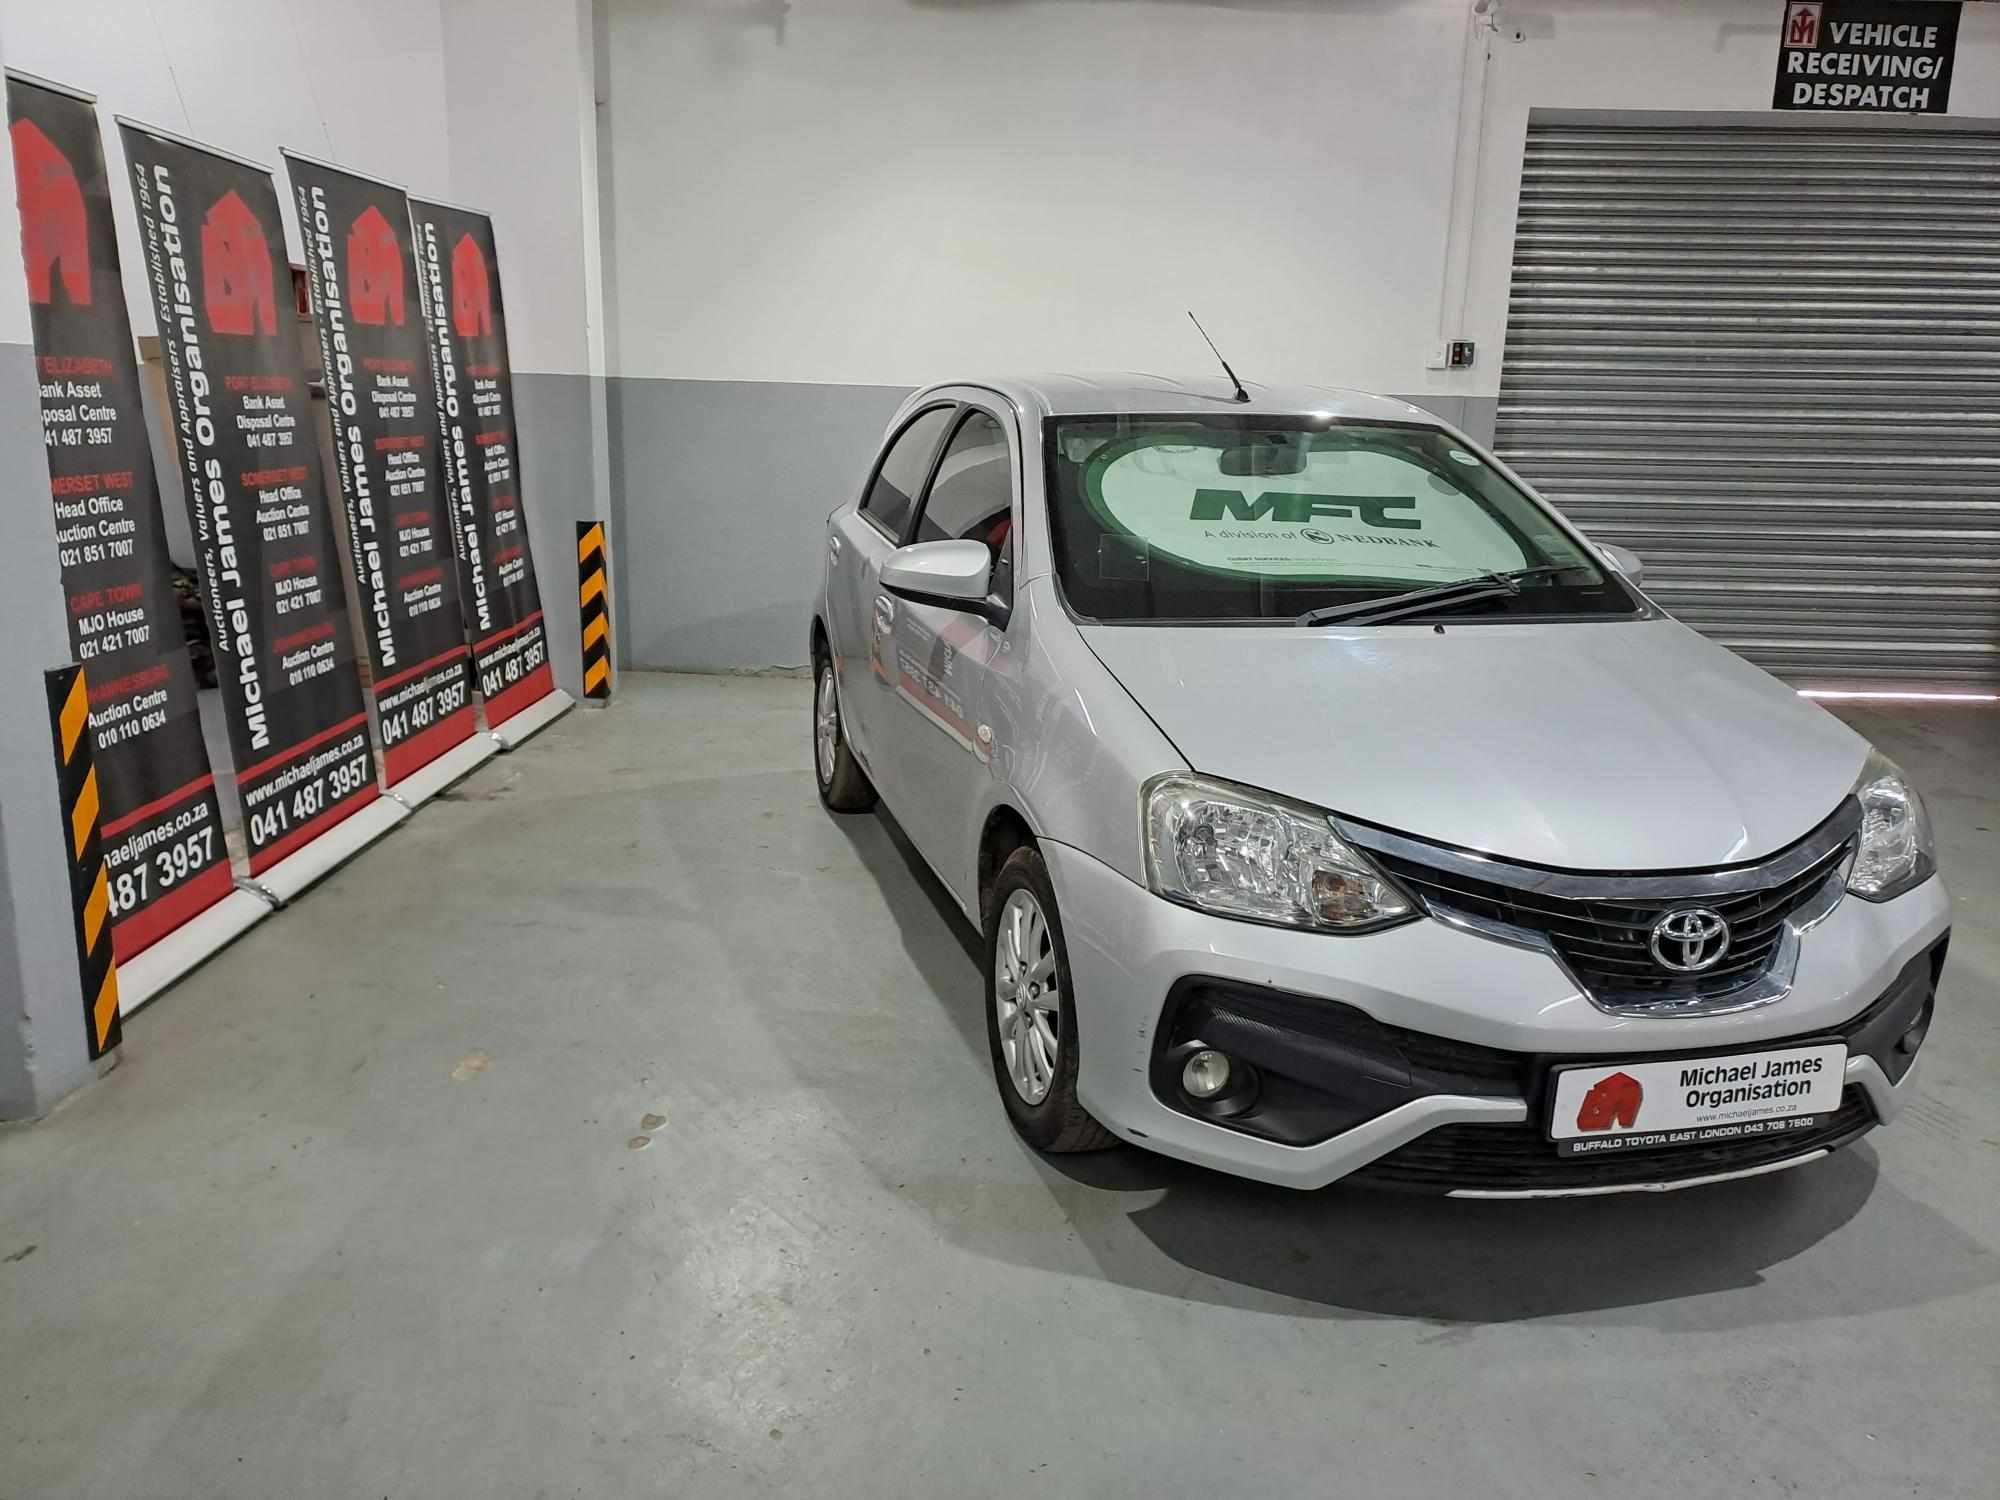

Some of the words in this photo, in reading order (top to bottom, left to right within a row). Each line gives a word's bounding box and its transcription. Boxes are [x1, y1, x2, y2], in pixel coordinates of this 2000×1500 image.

[1829, 22, 1938, 49] VEHICLE
[1787, 51, 1944, 80] RECEIVING/
[1792, 82, 1930, 109] DESPATCH
[134, 162, 154, 210] 1964
[147, 214, 173, 324] Established
[153, 164, 215, 447] Organisation
[311, 185, 357, 416] Organisation
[424, 222, 459, 417] Organisation
[66, 381, 102, 398] Asset
[167, 339, 193, 436] Appraisers
[41, 404, 77, 426] posal
[79, 404, 117, 422] Centre
[330, 407, 342, 437] and
[44, 428, 58, 446] 41
[61, 427, 82, 446] 487
[87, 427, 112, 444] 3957
[181, 437, 200, 473] and
[336, 440, 350, 493] Valuers
[347, 425, 376, 533] James
[451, 425, 475, 517] James
[54, 501, 86, 519] Head
[88, 496, 124, 514] Office
[98, 517, 136, 538] Centre
[190, 477, 210, 542] Valuers
[204, 458, 242, 588] James
[1190, 488, 1422, 530] MFC
[60, 547, 82, 567] 021
[84, 542, 106, 562] 851
[108, 538, 134, 559] 7007
[1204, 529, 1216, 539] A
[1218, 529, 1274, 541] division
[1281, 530, 1297, 541] of
[1337, 533, 1441, 550] NEDBANK
[463, 523, 492, 630] Michael
[78, 613, 105, 636] MJO
[107, 606, 145, 628] House
[204, 548, 230, 652] Auctioneers,
[363, 541, 397, 668] Michael
[79, 639, 99, 660] 021
[102, 632, 123, 653] 421
[125, 625, 151, 646] 7007
[282, 648, 311, 671] Auction
[226, 597, 270, 751] Michael
[482, 669, 503, 698] 041
[504, 656, 524, 683] 487
[524, 640, 545, 673] 3957
[87, 702, 132, 730] Auction
[133, 688, 169, 711] Centre
[98, 727, 119, 750] 010
[119, 718, 140, 741] 110
[141, 708, 168, 734] 0634
[381, 711, 410, 746] 041
[410, 697, 435, 731] 487
[437, 680, 466, 717] 3957
[245, 732, 365, 808] www.michaeljames.co.za
[250, 798, 289, 847] 041
[292, 778, 325, 821] 487
[328, 753, 369, 801] 3957
[154, 825, 214, 889] 3957
[1679, 1059, 1757, 1089] Michael
[1760, 1056, 1823, 1081] James
[1685, 1077, 1812, 1109] Organisation
[1573, 1138, 1622, 1152] BUFFALO
[1624, 1133, 1667, 1147] TOYOTA
[1669, 1130, 1697, 1143] EAST
[1699, 1125, 1742, 1139] LONDON
[1744, 1122, 1764, 1134] 043
